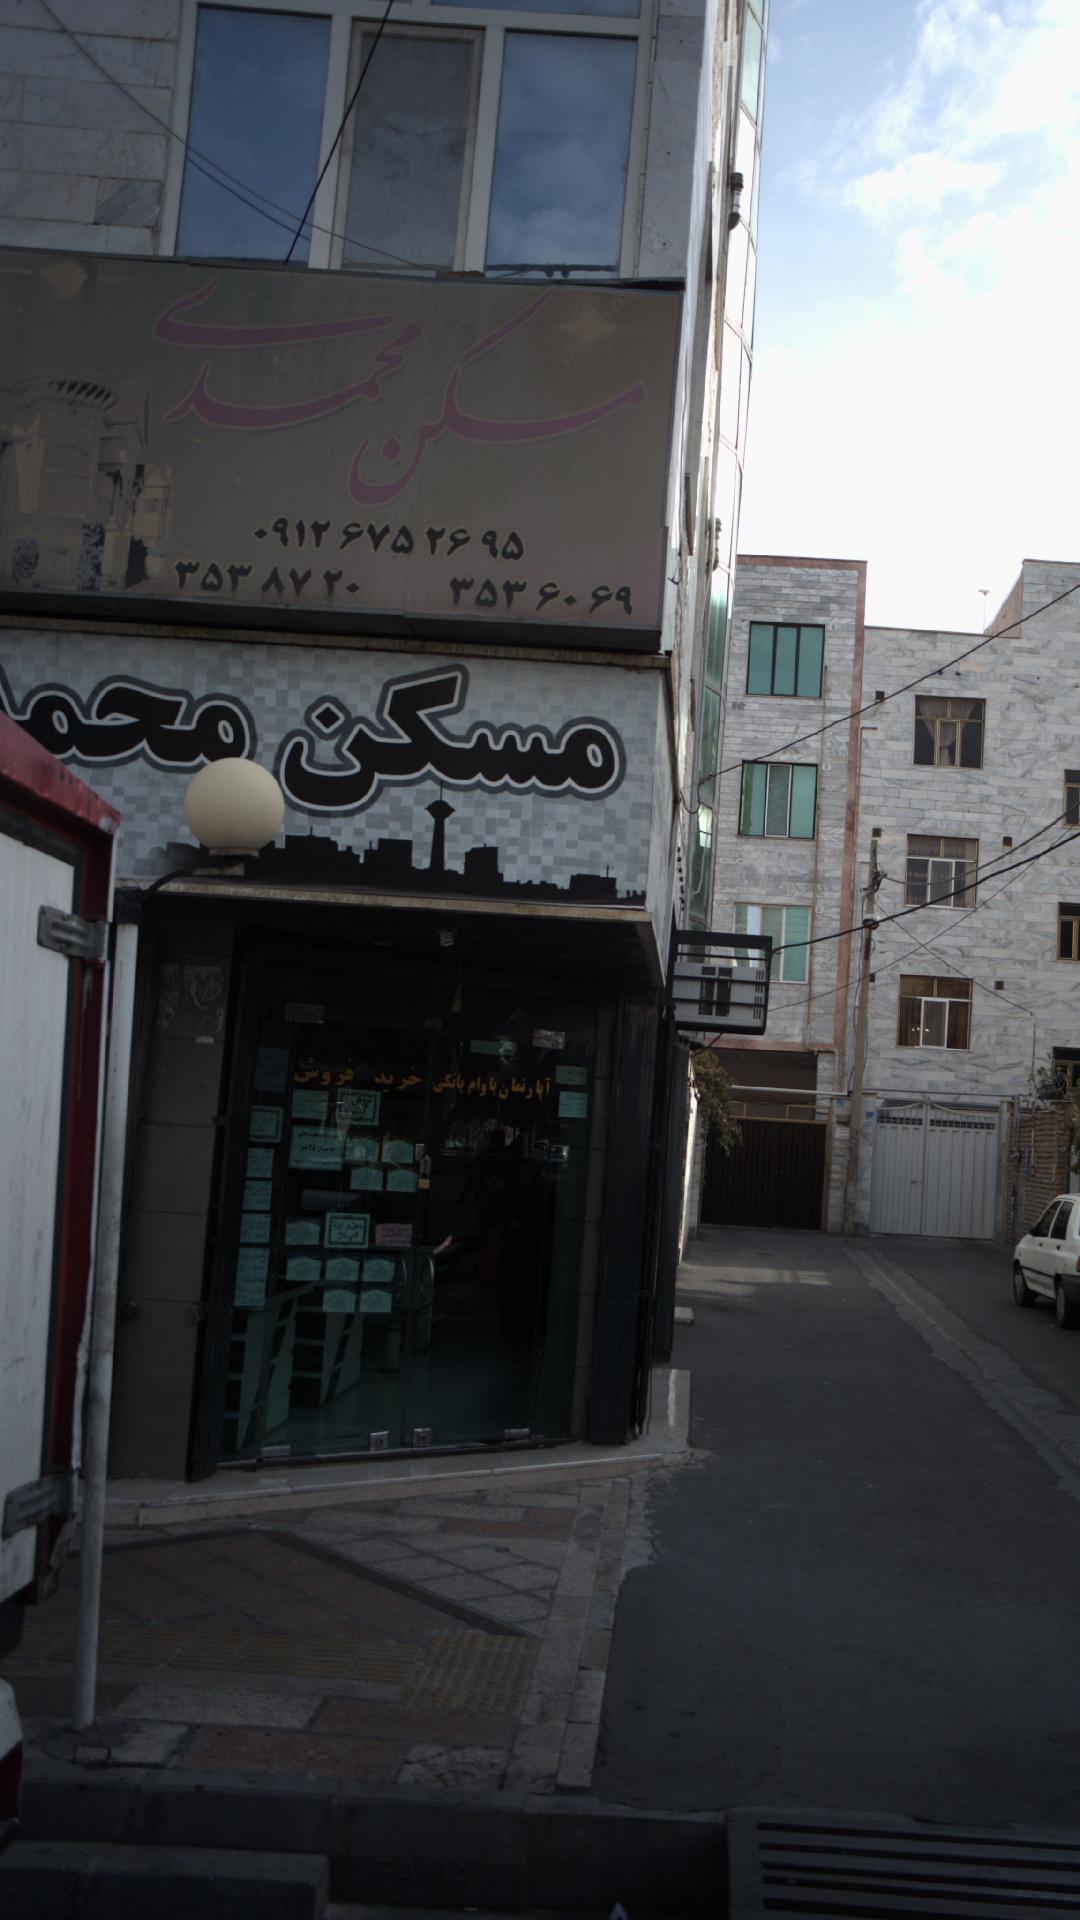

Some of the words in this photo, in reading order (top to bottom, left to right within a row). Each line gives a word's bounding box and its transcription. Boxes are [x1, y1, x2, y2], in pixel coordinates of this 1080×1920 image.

[0, 663, 255, 772] محم
[281, 665, 625, 816] مسکن
[293, 1056, 355, 1088] فروش
[373, 1064, 425, 1094] خرید
